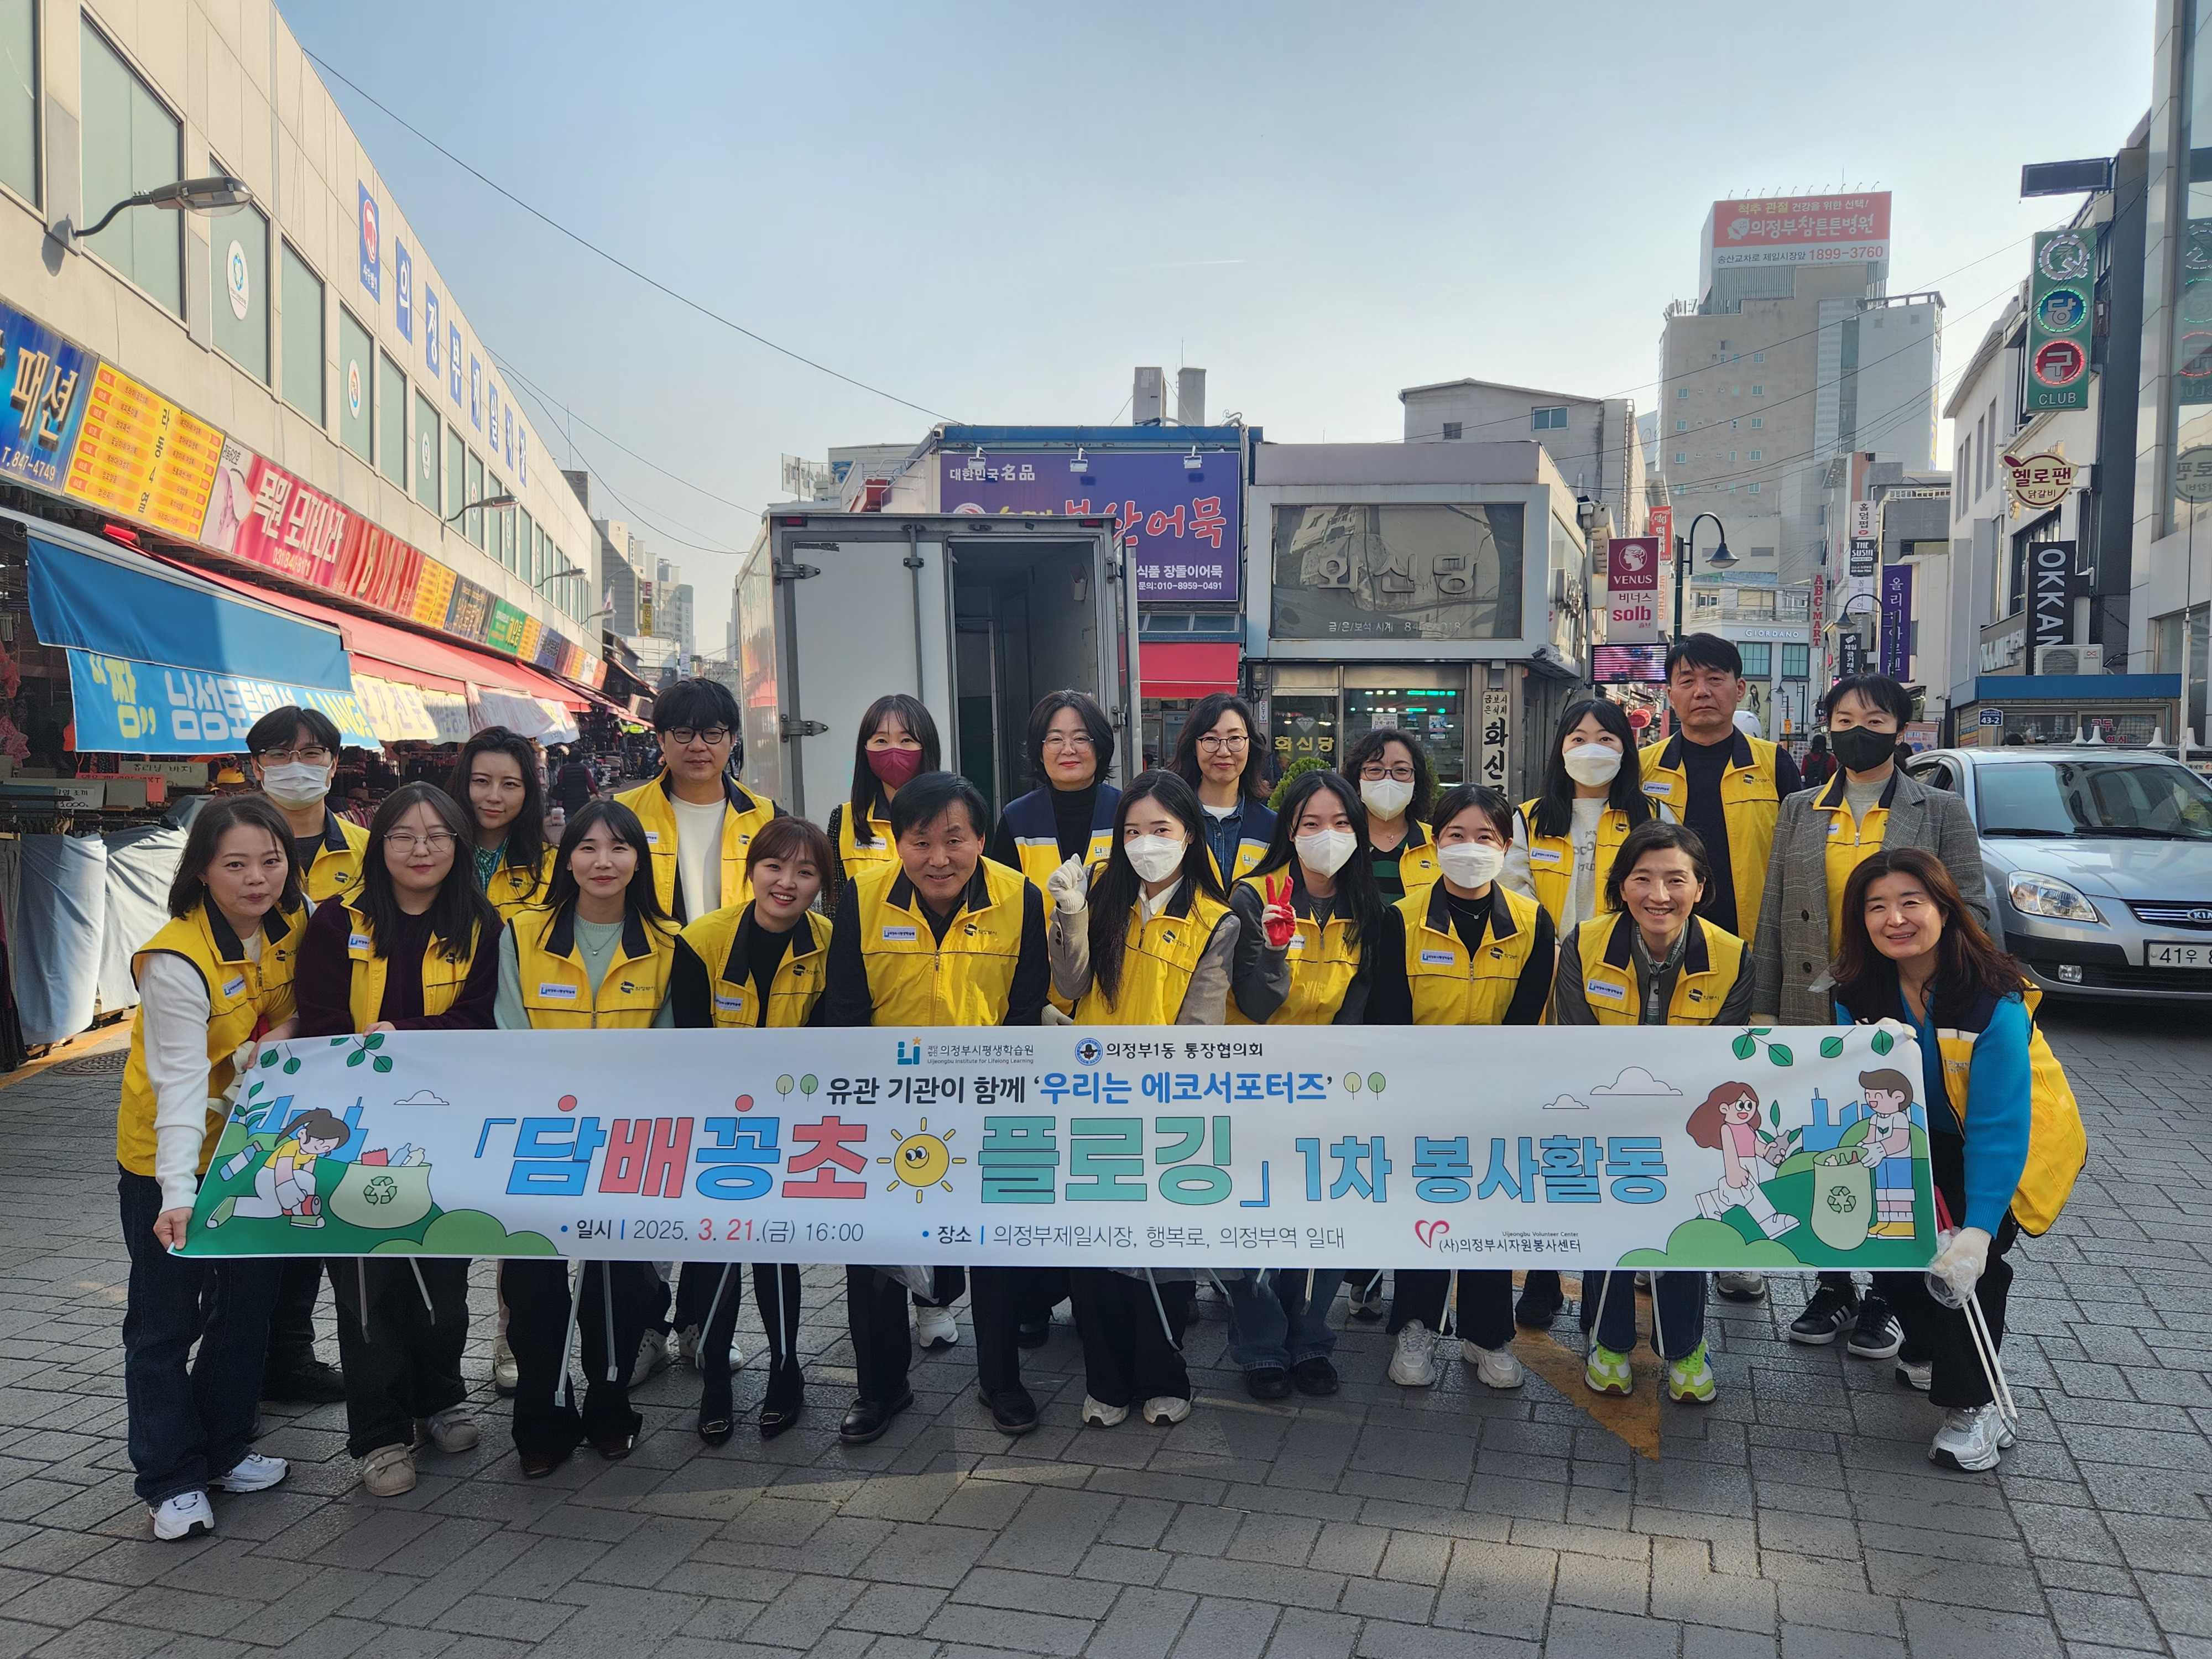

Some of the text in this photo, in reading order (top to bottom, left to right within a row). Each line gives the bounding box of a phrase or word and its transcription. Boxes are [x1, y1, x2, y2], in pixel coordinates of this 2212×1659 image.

[1739, 199, 1869, 215] 척추 관절 건강을 위한 선택!
[1750, 213, 1874, 239] 의정부참튼튼병원
[1718, 246, 1884, 264] 송산교차로 제일시장앞 1899-3760
[2038, 392, 2077, 405] CLUB
[2, 446, 56, 482] T.847-4749
[950, 463, 1036, 481] 대한민국 名品
[2011, 467, 2072, 488] 헬로팬
[2027, 489, 2057, 499] 닭갈비
[254, 468, 293, 540] 목원
[284, 487, 347, 564] 모자나라
[1858, 503, 1869, 529] 홀덤펍
[1136, 564, 1223, 579] 식품 장돌이어묵
[1317, 554, 1480, 594] 화신당
[1138, 581, 1223, 591] 문의:010-8959-0491
[1614, 575, 1652, 585] VENUS
[1619, 592, 1652, 604] 비너스
[1613, 606, 1651, 621] solb
[1329, 621, 1371, 633] 금/은/보석
[1376, 621, 1393, 633] 시계
[1745, 629, 1799, 639] GIORDANO
[1274, 736, 1334, 752] 화신당
[169, 765, 192, 773] 바지
[2159, 947, 2198, 964] 41우
[941, 1045, 1034, 1057] 의정부시평생학습원
[1107, 1042, 1262, 1060] 의정부1동 통장협의회
[826, 1077, 880, 1105] 유관
[888, 1077, 964, 1104] 기관이
[974, 1076, 1025, 1104] 함께
[1296, 1136, 1392, 1204] 1차
[1412, 1134, 1668, 1204] 봉사활동
[577, 1220, 612, 1240] 일시
[634, 1220, 689, 1241] 2025.
[806, 1223, 864, 1242] 16:00
[937, 1225, 1345, 1250] 장소 의정부제일시장, 행복로, 의정부역 일대
[1439, 1238, 1582, 1253] (사)의정부시자원봉사센터
